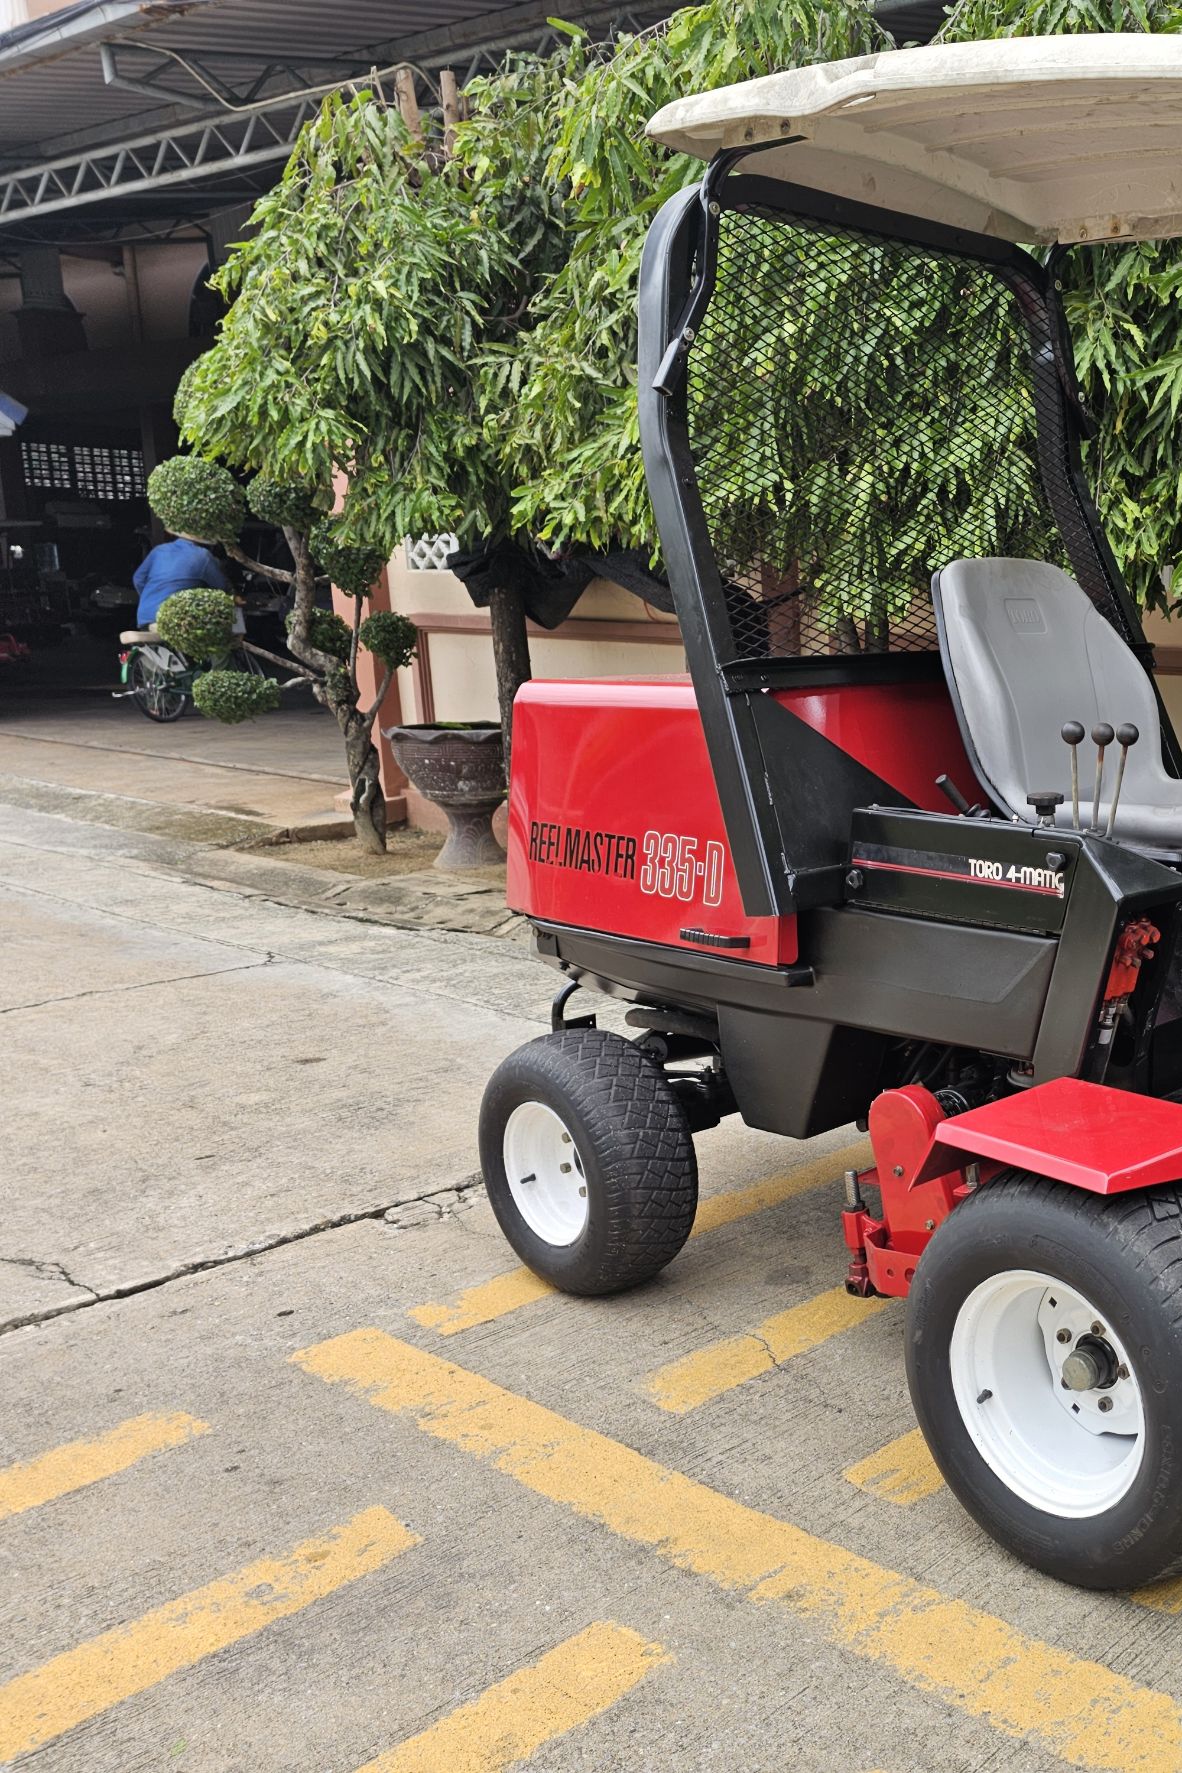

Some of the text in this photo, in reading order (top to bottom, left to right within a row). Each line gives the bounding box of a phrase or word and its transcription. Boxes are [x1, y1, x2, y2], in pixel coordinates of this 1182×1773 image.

[529, 821, 725, 907] REELMASTER 335-D
[968, 858, 1065, 891] TORO 4-MATIC
